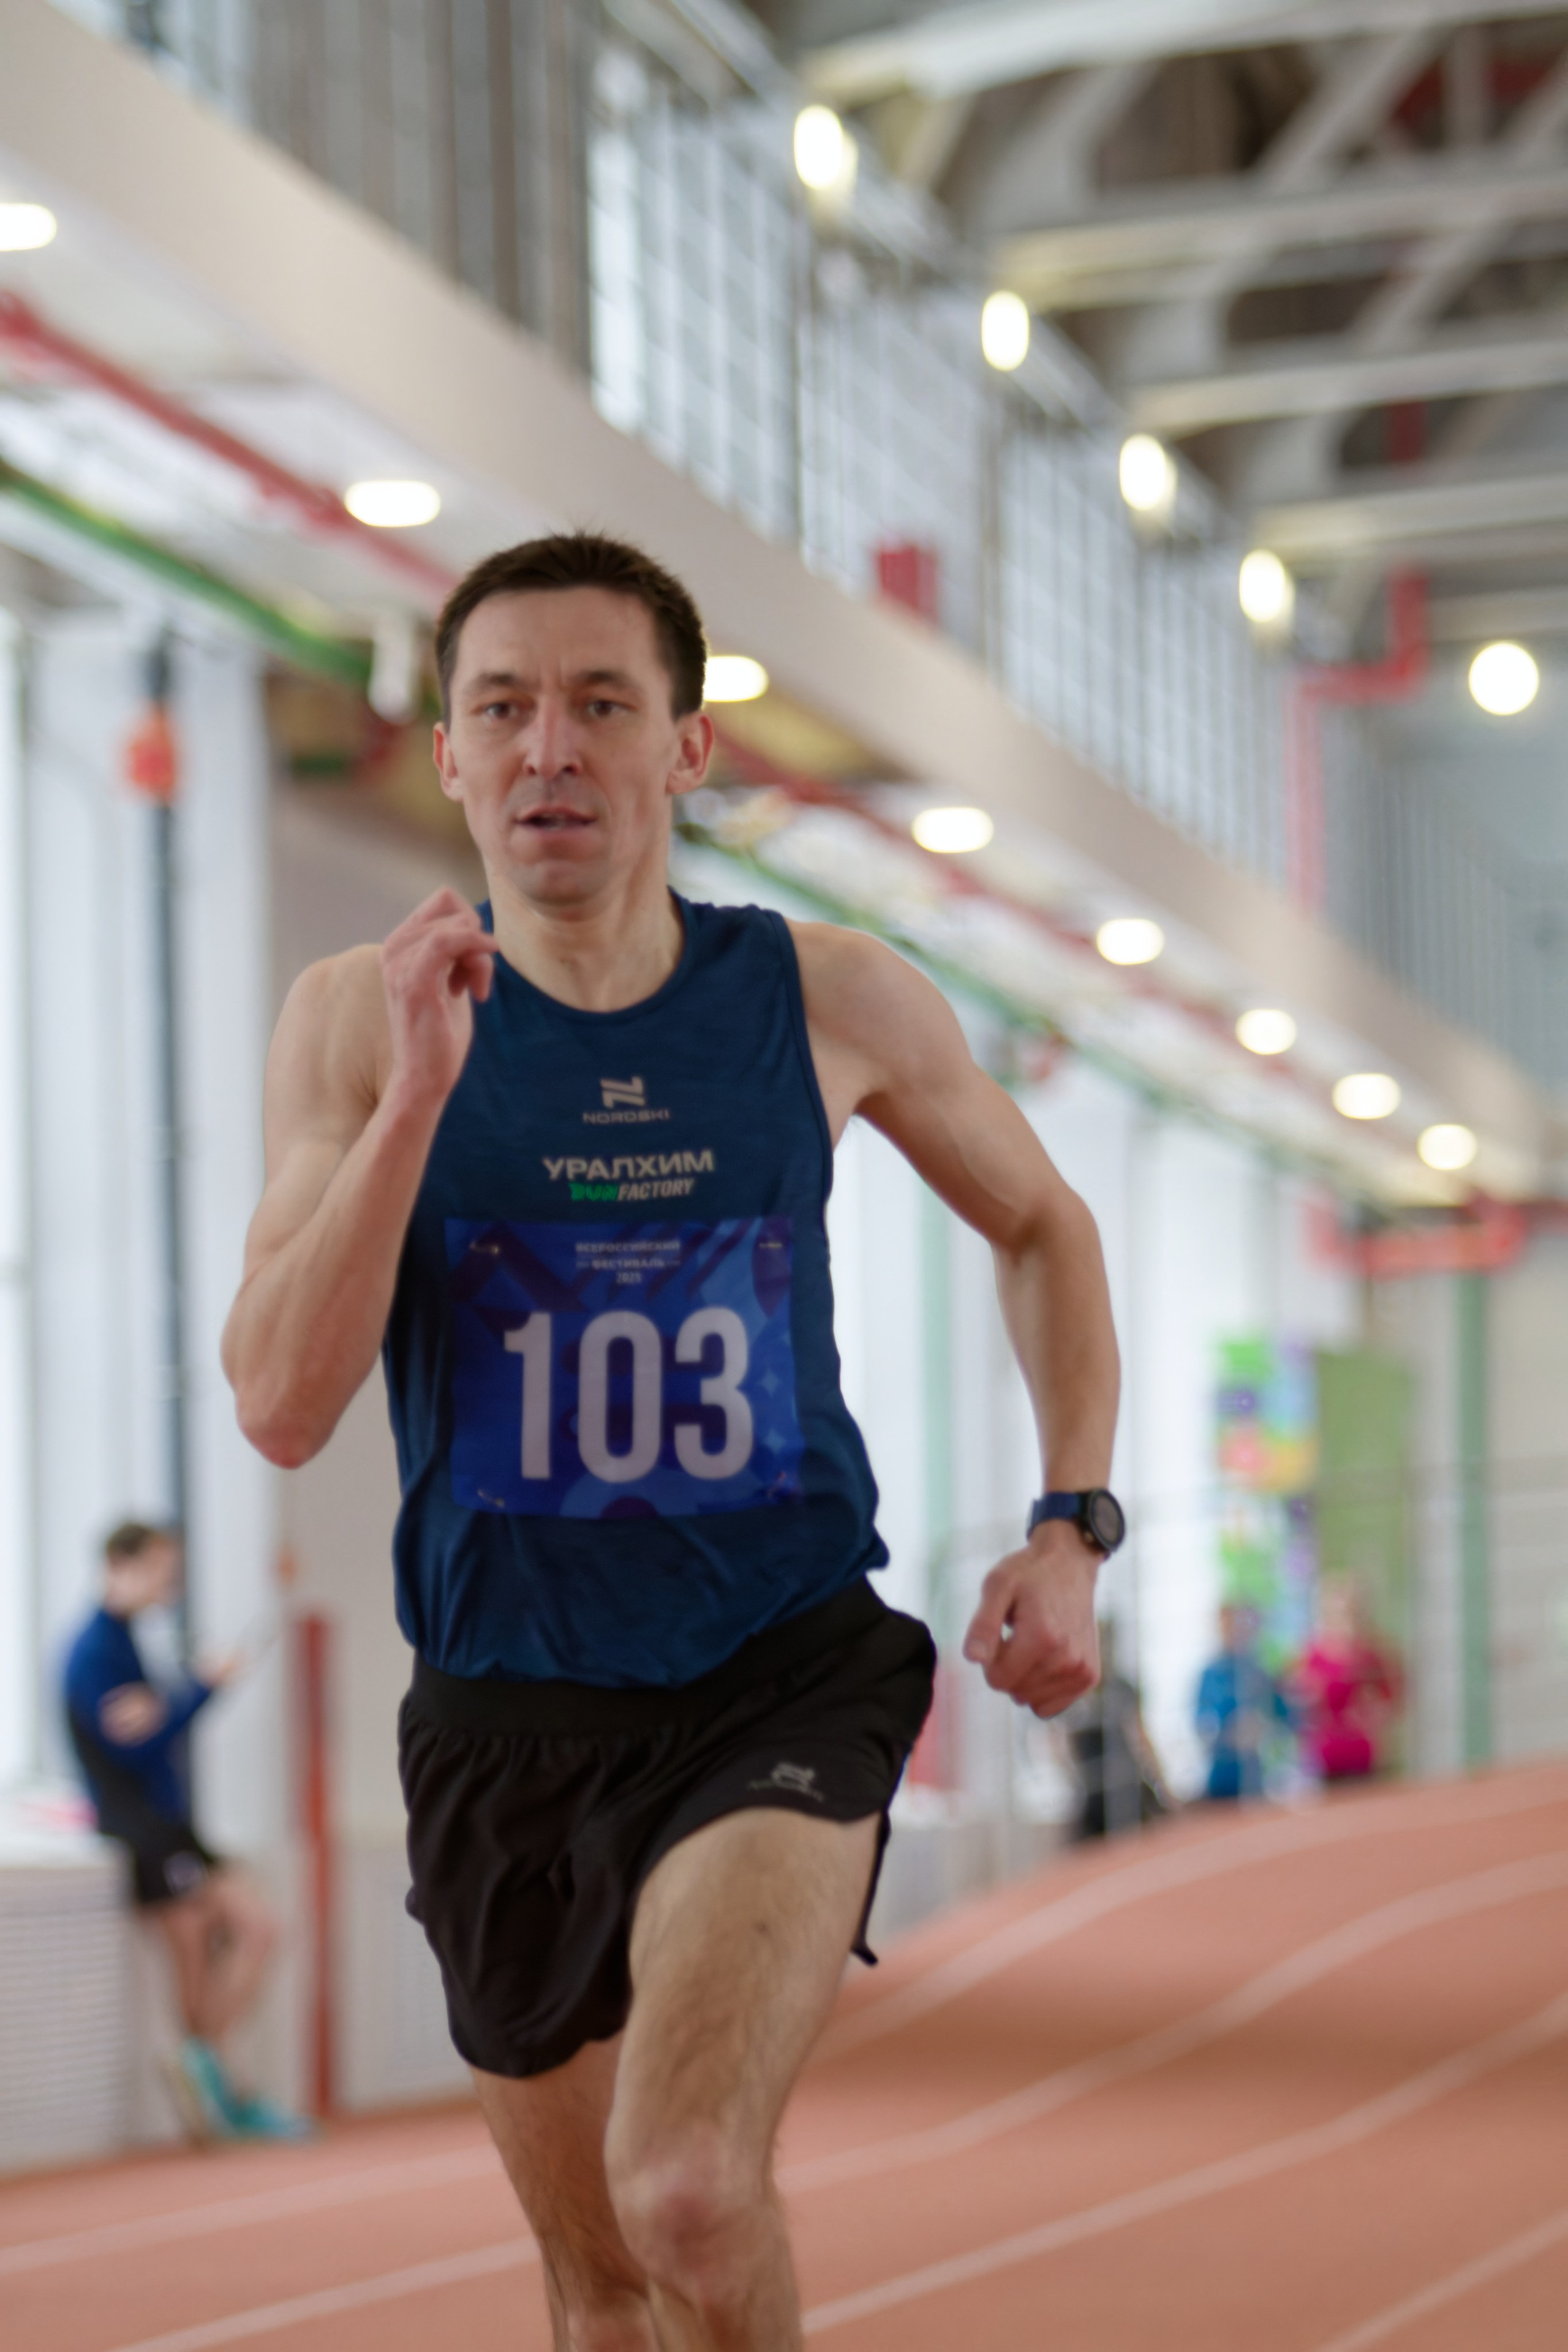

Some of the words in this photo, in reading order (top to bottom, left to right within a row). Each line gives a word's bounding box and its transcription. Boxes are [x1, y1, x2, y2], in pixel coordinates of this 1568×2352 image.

[582, 1109, 670, 1125] NORDSKI
[543, 1149, 714, 1180] УРАЛХИМ
[504, 1307, 753, 1483] 103
